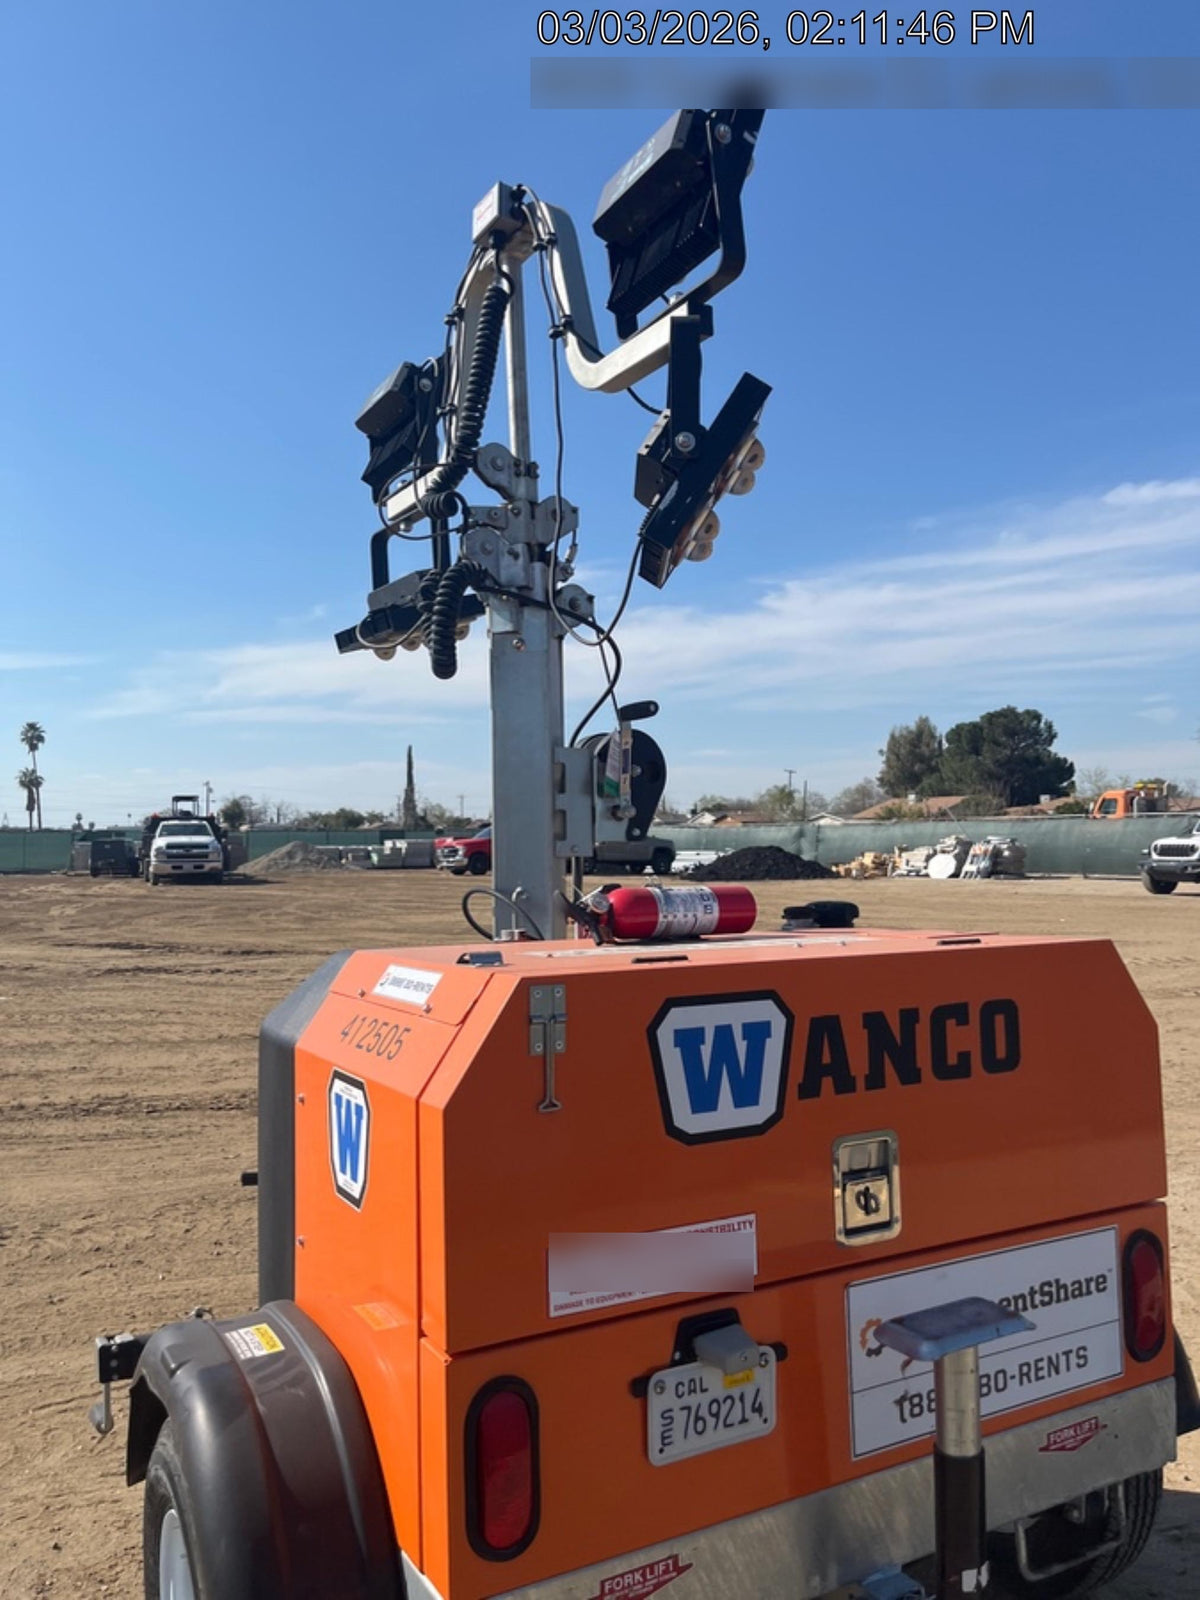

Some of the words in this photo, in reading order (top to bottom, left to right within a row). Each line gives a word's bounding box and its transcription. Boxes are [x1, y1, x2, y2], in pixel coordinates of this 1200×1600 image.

[341, 1014, 411, 1060] 412505
[674, 998, 1021, 1115] WANCO
[334, 1092, 363, 1184] W
[999, 1273, 1108, 1315] entShare
[674, 1376, 709, 1399] CAL
[679, 1387, 764, 1440] 769214
[1050, 1427, 1076, 1444] FORK
[1077, 1418, 1097, 1436] LIFT
[604, 1571, 644, 1594] FORK
[646, 1559, 674, 1579] LIFT
